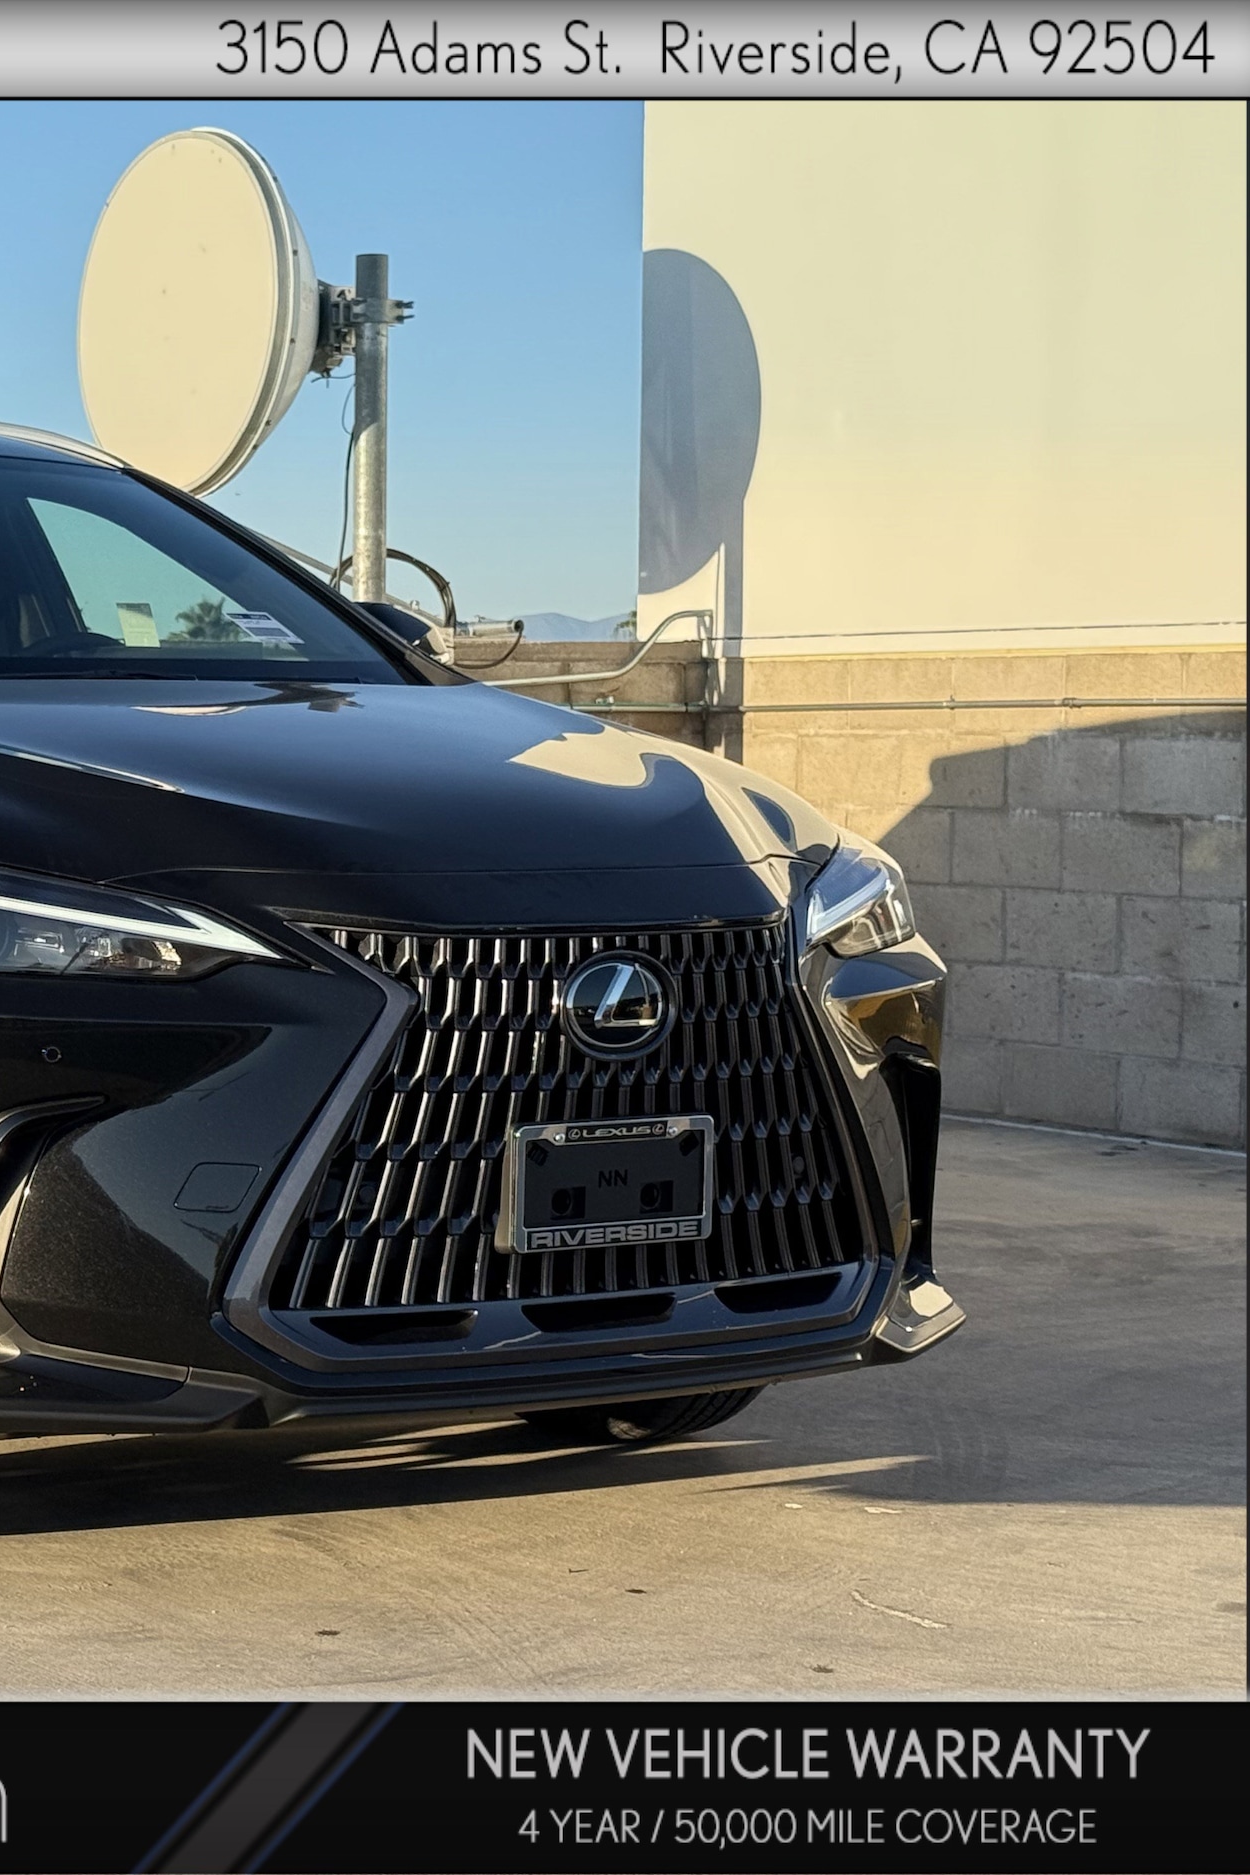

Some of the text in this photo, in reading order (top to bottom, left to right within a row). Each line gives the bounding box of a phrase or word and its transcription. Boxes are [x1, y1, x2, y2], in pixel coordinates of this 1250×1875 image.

[582, 1126, 652, 1138] LEXUS
[598, 1169, 628, 1188] NN
[531, 1221, 699, 1249] RIVERSIDE
